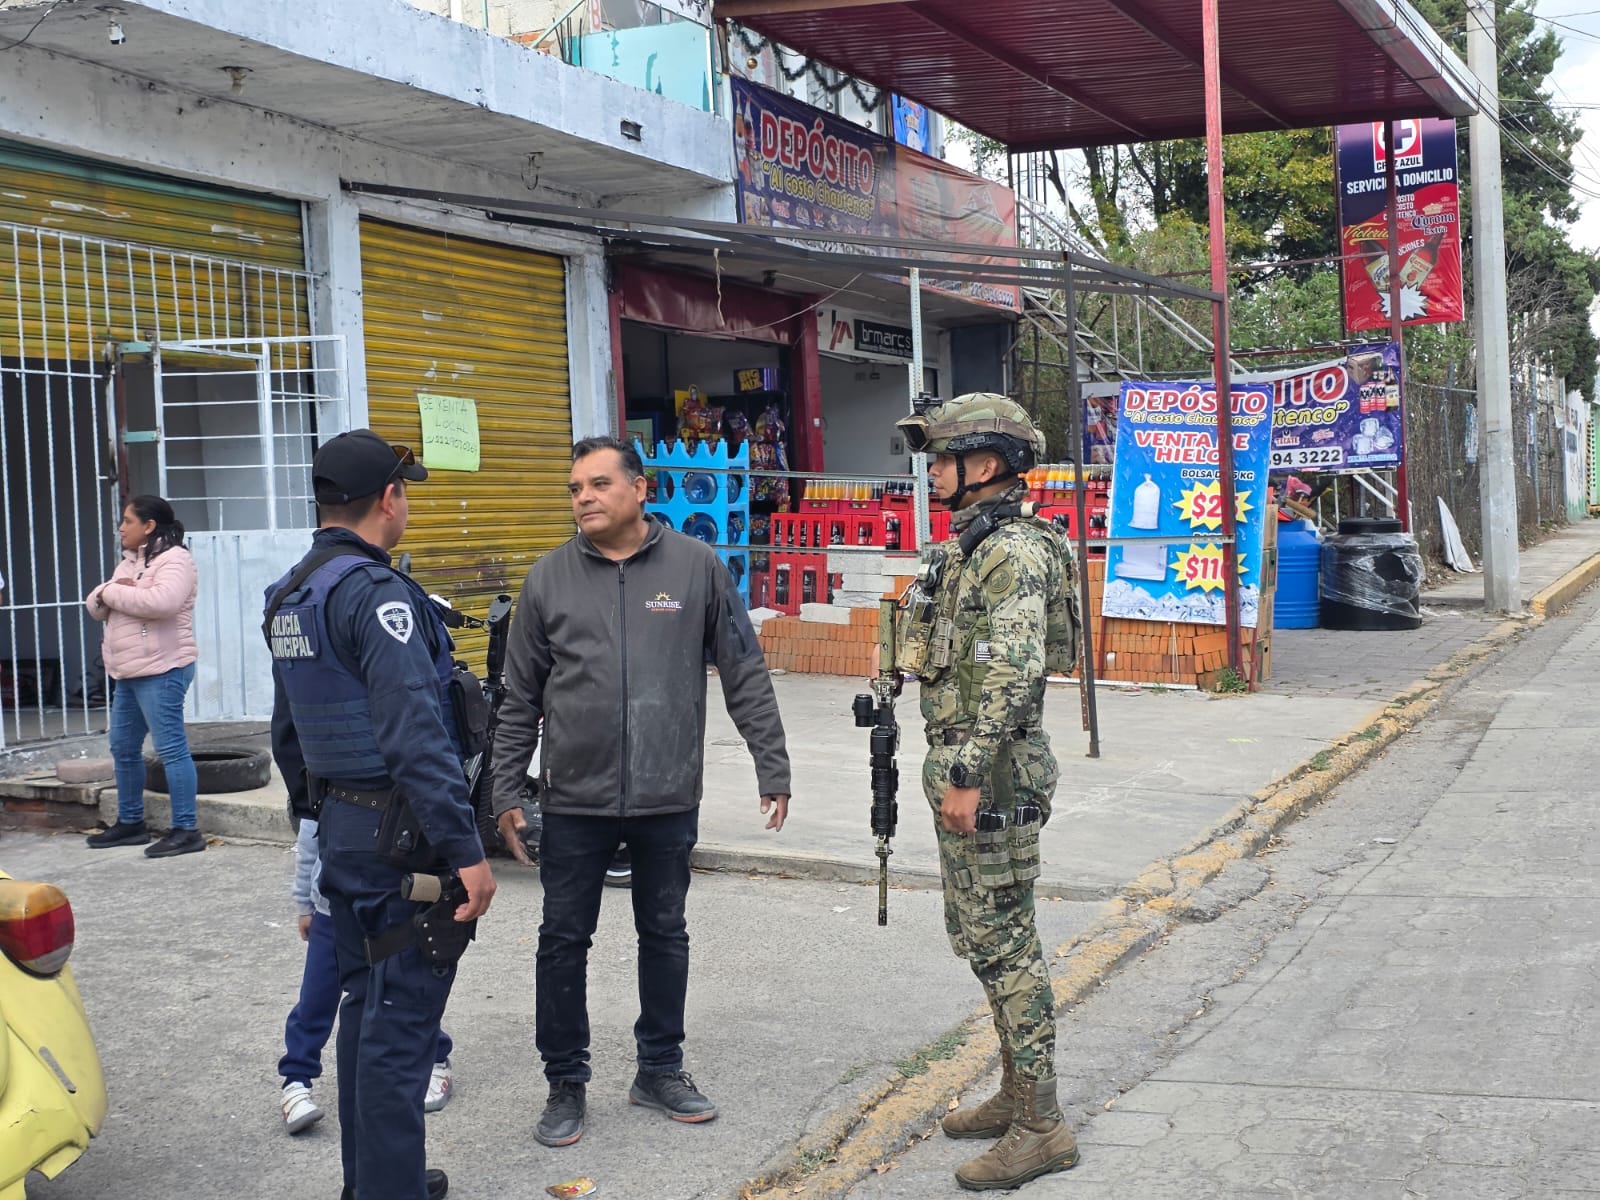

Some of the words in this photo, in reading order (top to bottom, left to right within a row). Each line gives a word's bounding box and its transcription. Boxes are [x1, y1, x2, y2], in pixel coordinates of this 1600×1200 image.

[760, 109, 875, 196] DEPÓSITO
[1376, 157, 1399, 171] CRZ
[1400, 156, 1422, 168] AZUL
[785, 173, 815, 203] costo
[1346, 177, 1387, 195] SERVICI
[1403, 167, 1453, 187] DOMICILIO
[1412, 213, 1455, 230] Corona
[1424, 225, 1448, 236] Extra
[1125, 386, 1268, 413] DEPÓSTO
[1148, 413, 1183, 425] costo
[1135, 430, 1213, 449] VENTA
[1155, 446, 1220, 464] HIELO
[1269, 452, 1292, 466] 94
[1299, 449, 1341, 464] 3222
[1182, 469, 1213, 478] BOLSA
[1240, 472, 1254, 480] KG
[1191, 491, 1239, 520] $2
[645, 600, 682, 609] SUNRISE
